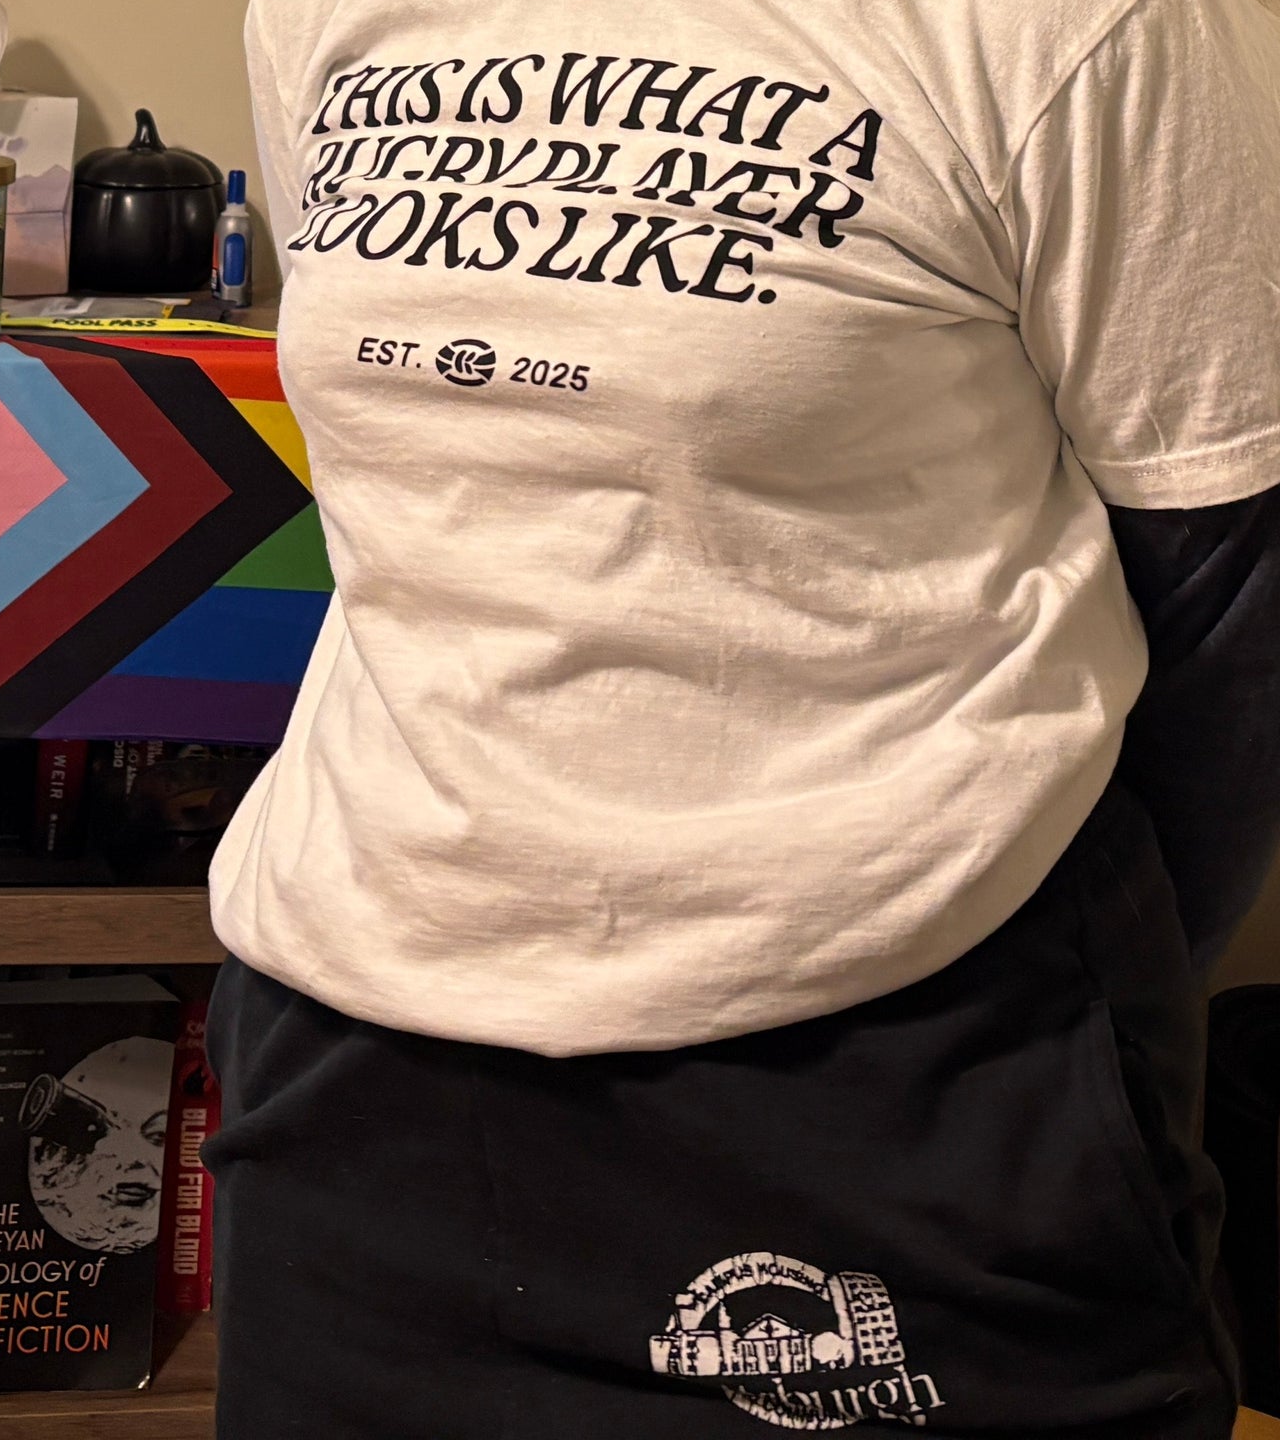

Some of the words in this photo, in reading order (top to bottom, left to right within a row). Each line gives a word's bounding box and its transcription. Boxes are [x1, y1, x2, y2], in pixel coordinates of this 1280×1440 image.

[312, 58, 465, 134] THIS
[455, 54, 545, 124] IS
[549, 52, 830, 151] WHAT
[809, 108, 883, 181] A
[287, 189, 539, 271] LOOKS
[525, 206, 777, 304] LIKE.
[52, 318, 104, 327] POOL
[108, 318, 158, 327] PASS
[357, 337, 422, 369] EST.
[509, 356, 591, 392] 2025
[49, 754, 67, 800] WEIR
[179, 1108, 207, 1168] BLOOD
[176, 1173, 204, 1210] FOR
[79, 1257, 108, 1287] of
[173, 1215, 201, 1275] BLOOD
